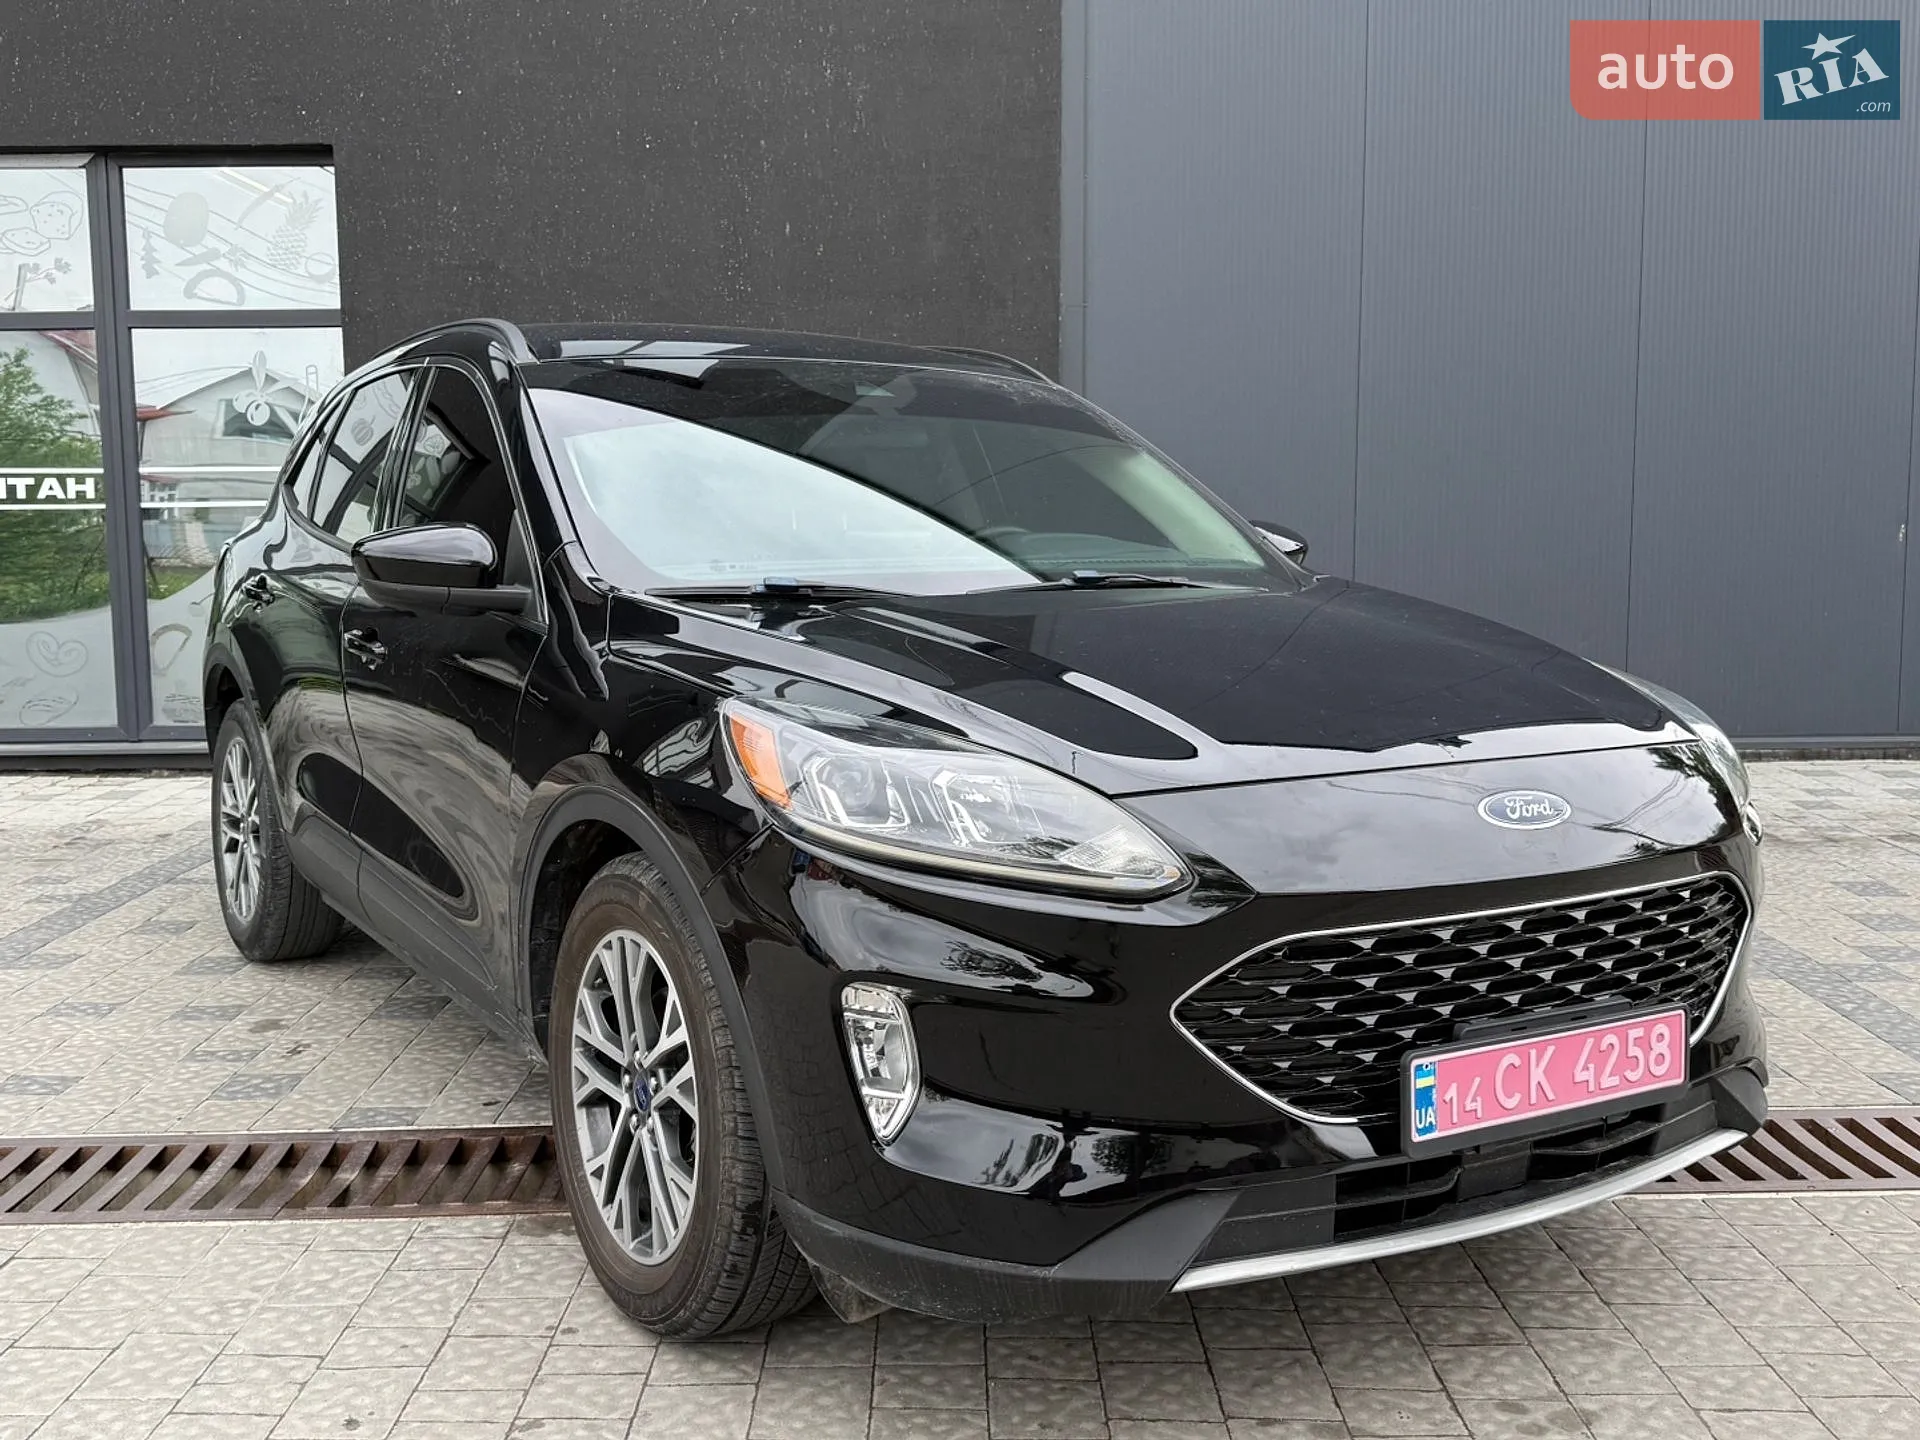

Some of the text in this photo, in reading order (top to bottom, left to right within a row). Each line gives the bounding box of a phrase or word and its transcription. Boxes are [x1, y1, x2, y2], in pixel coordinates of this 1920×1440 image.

[1504, 796, 1555, 820] Ford
[1442, 1023, 1673, 1125] 14 CK 4258
[1415, 1106, 1437, 1129] UA
